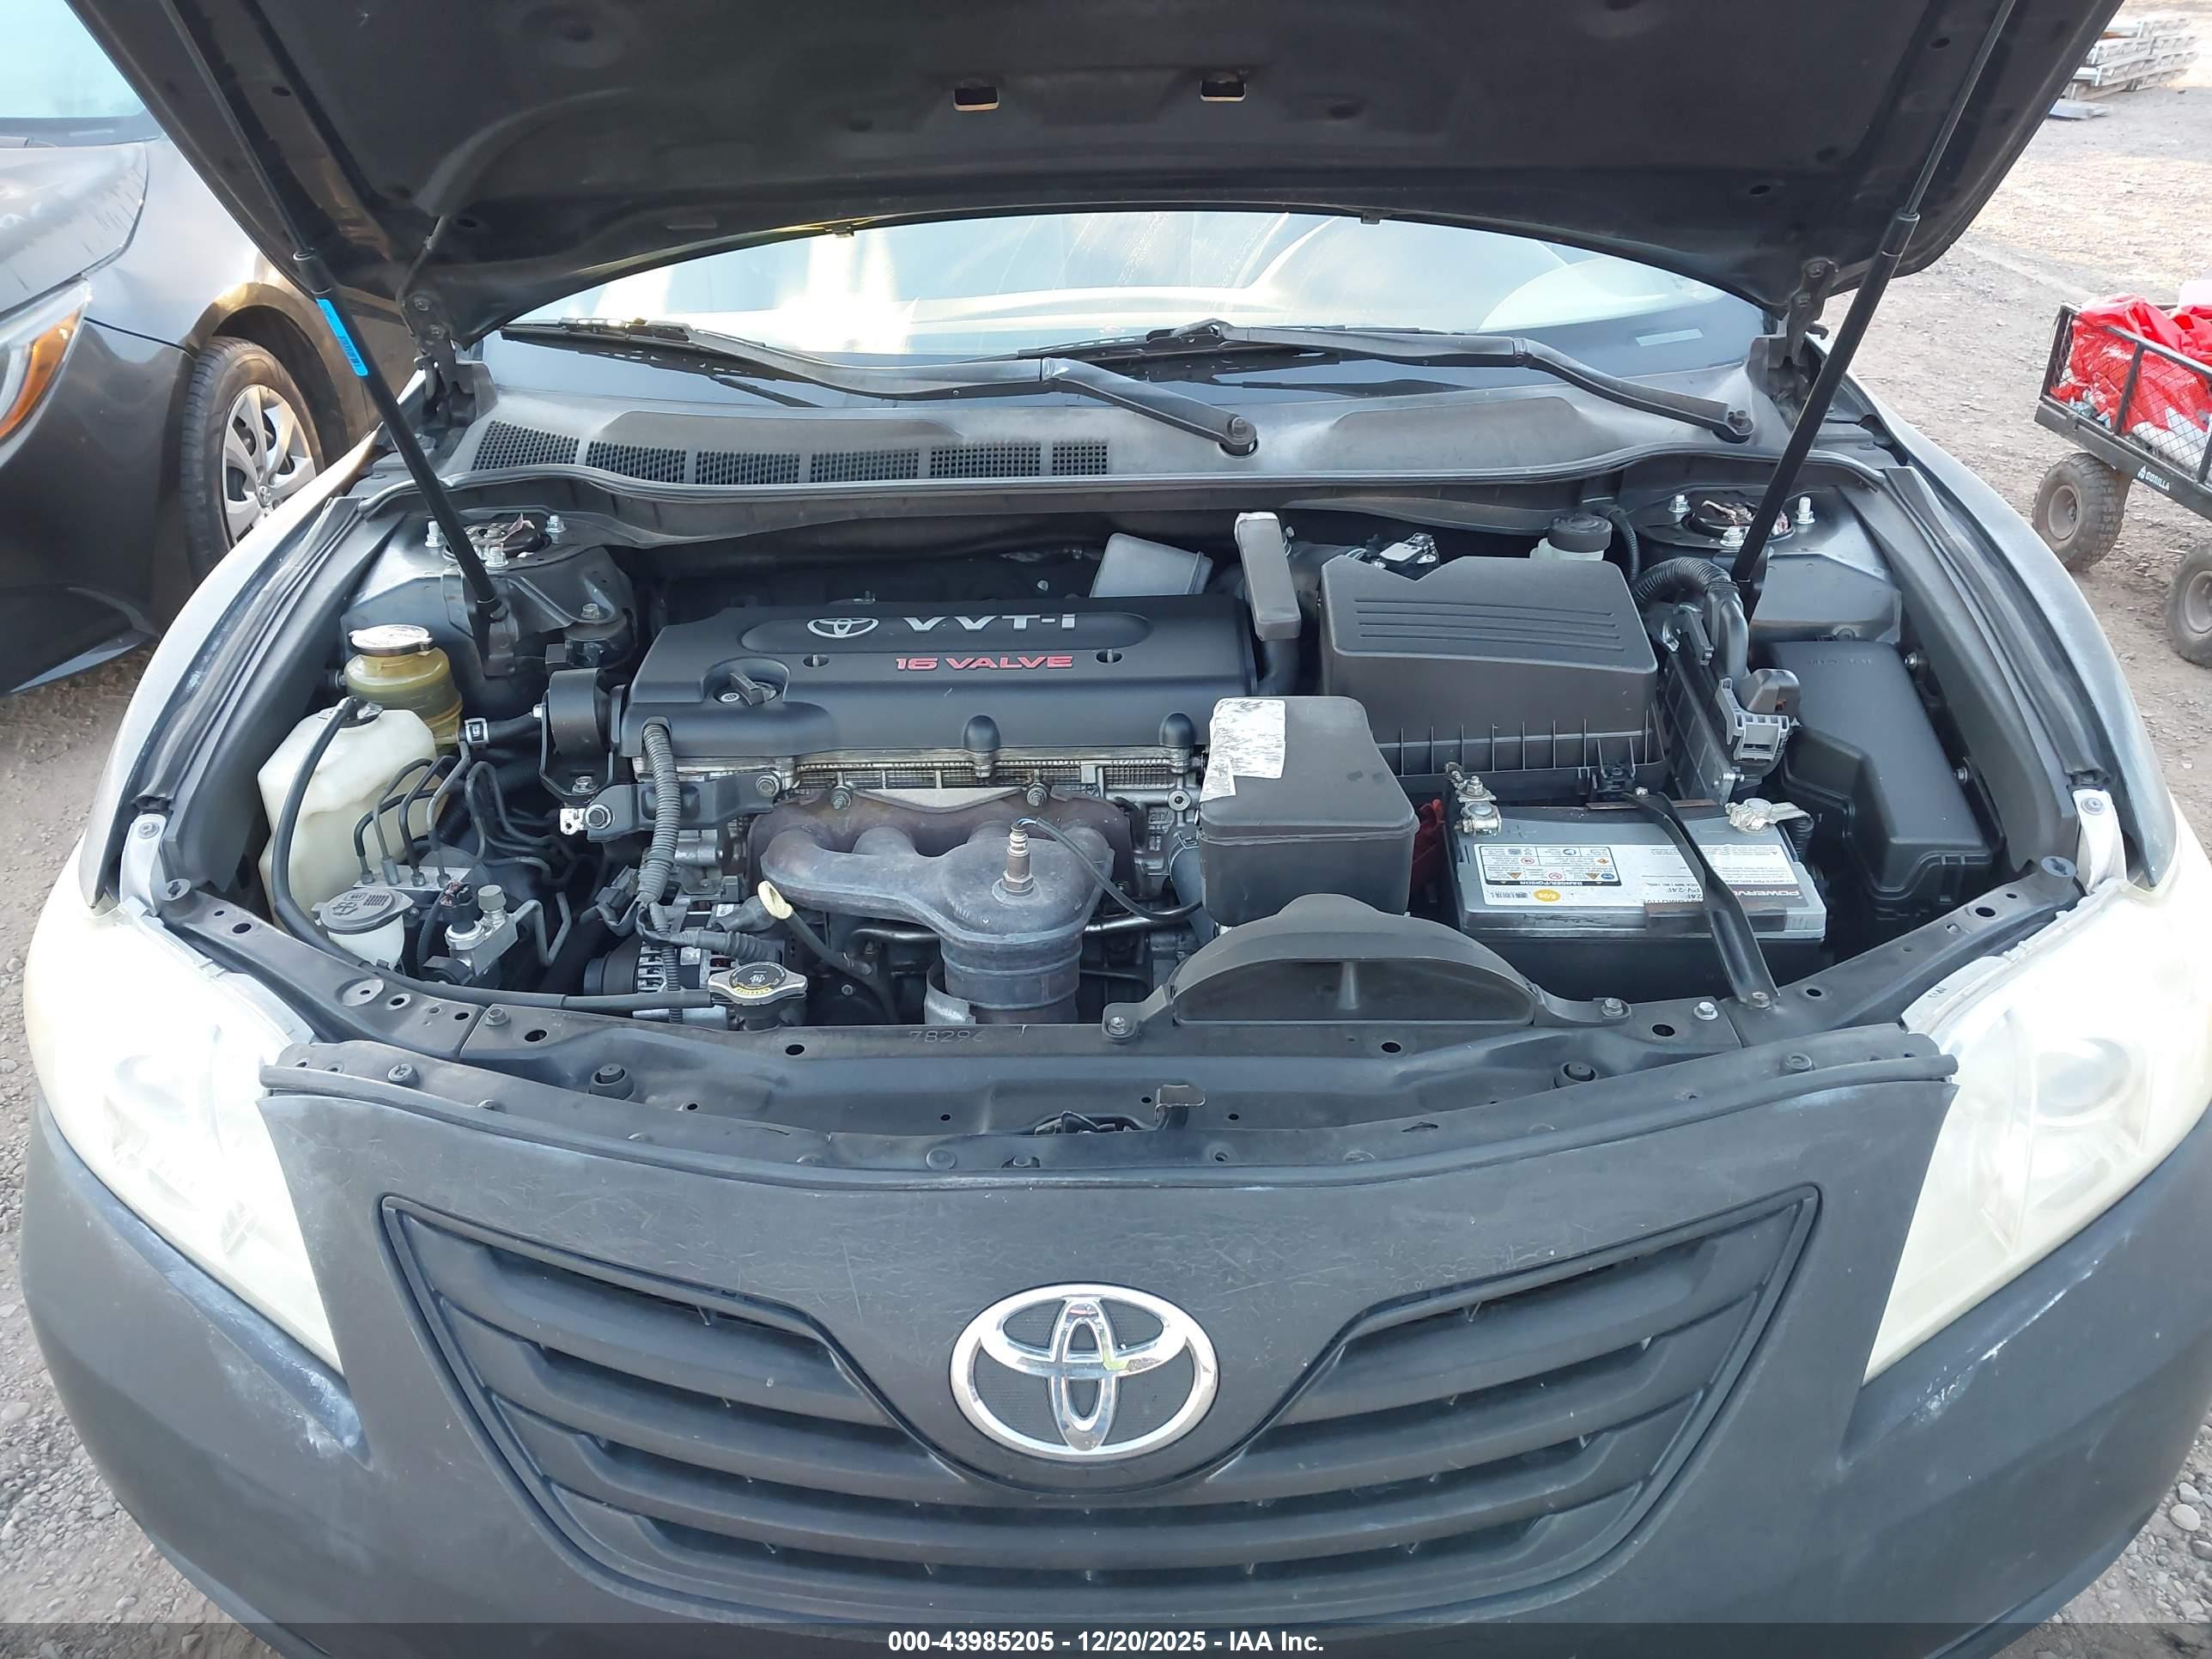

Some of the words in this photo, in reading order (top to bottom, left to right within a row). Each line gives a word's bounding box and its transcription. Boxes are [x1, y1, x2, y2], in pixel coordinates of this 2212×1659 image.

[2145, 471, 2170, 491] GORILLA
[896, 657, 939, 671] 16
[945, 655, 1073, 671] VALVE
[908, 1030, 987, 1042] 78296
